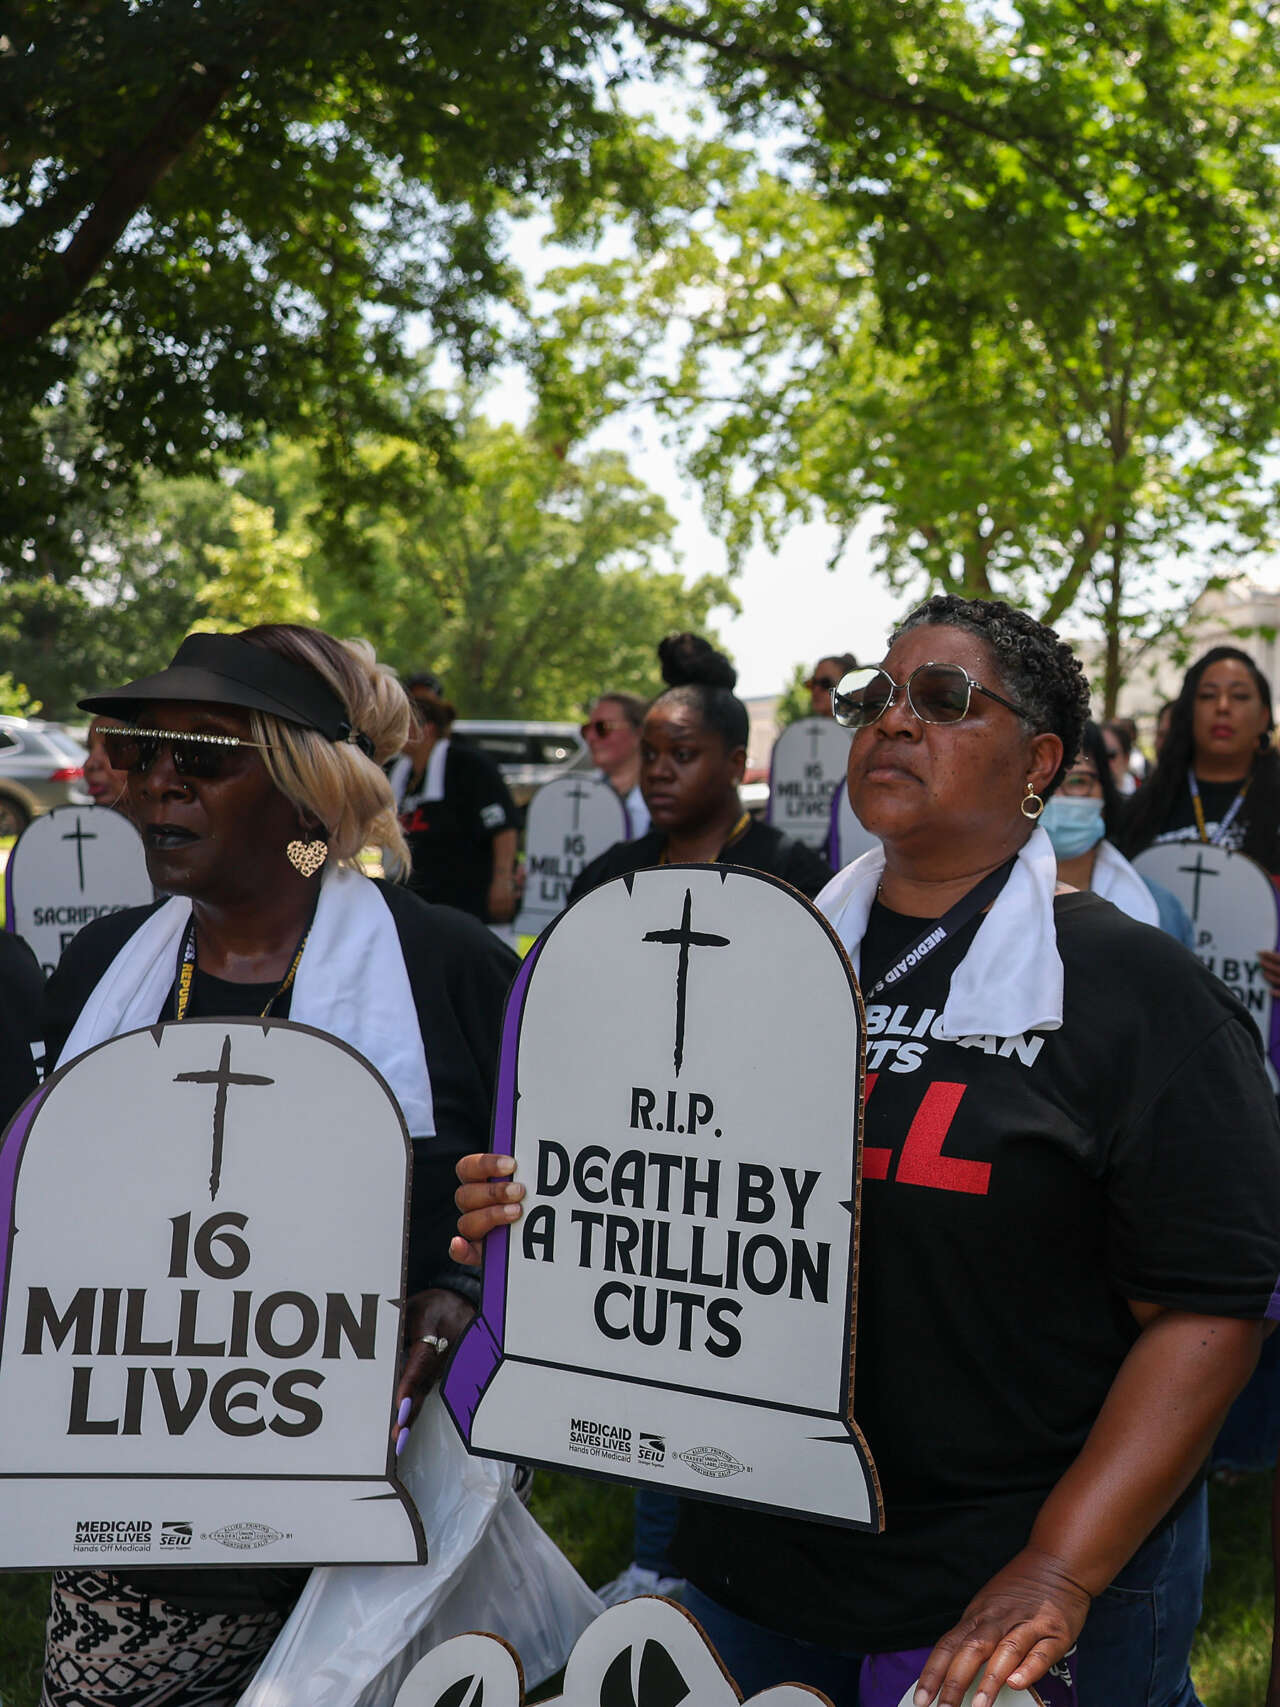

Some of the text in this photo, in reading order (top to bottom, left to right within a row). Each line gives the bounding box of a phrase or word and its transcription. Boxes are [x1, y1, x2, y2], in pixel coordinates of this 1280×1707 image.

[564, 835, 586, 856] 16
[885, 926, 947, 983] MEDICAID
[1223, 958, 1260, 983] BY
[630, 1087, 723, 1138] R.I.P.
[536, 1139, 822, 1230] DEATH BY
[168, 1211, 251, 1280] 16
[522, 1204, 831, 1304] A TRILLION
[21, 1287, 380, 1360] MILLION
[593, 1280, 744, 1358] CUTS
[66, 1367, 326, 1437] LIVES
[570, 1418, 632, 1441] MEDICAID
[569, 1445, 631, 1463] Hands Off Medicaid
[570, 1431, 631, 1453] SAVES LIVES
[637, 1449, 665, 1462] SEIU
[75, 1533, 152, 1543] SAVES LIVES
[76, 1521, 152, 1532] MEDICAID
[73, 1543, 151, 1552] Hands Off Medicaid
[159, 1536, 192, 1545] SEIU
